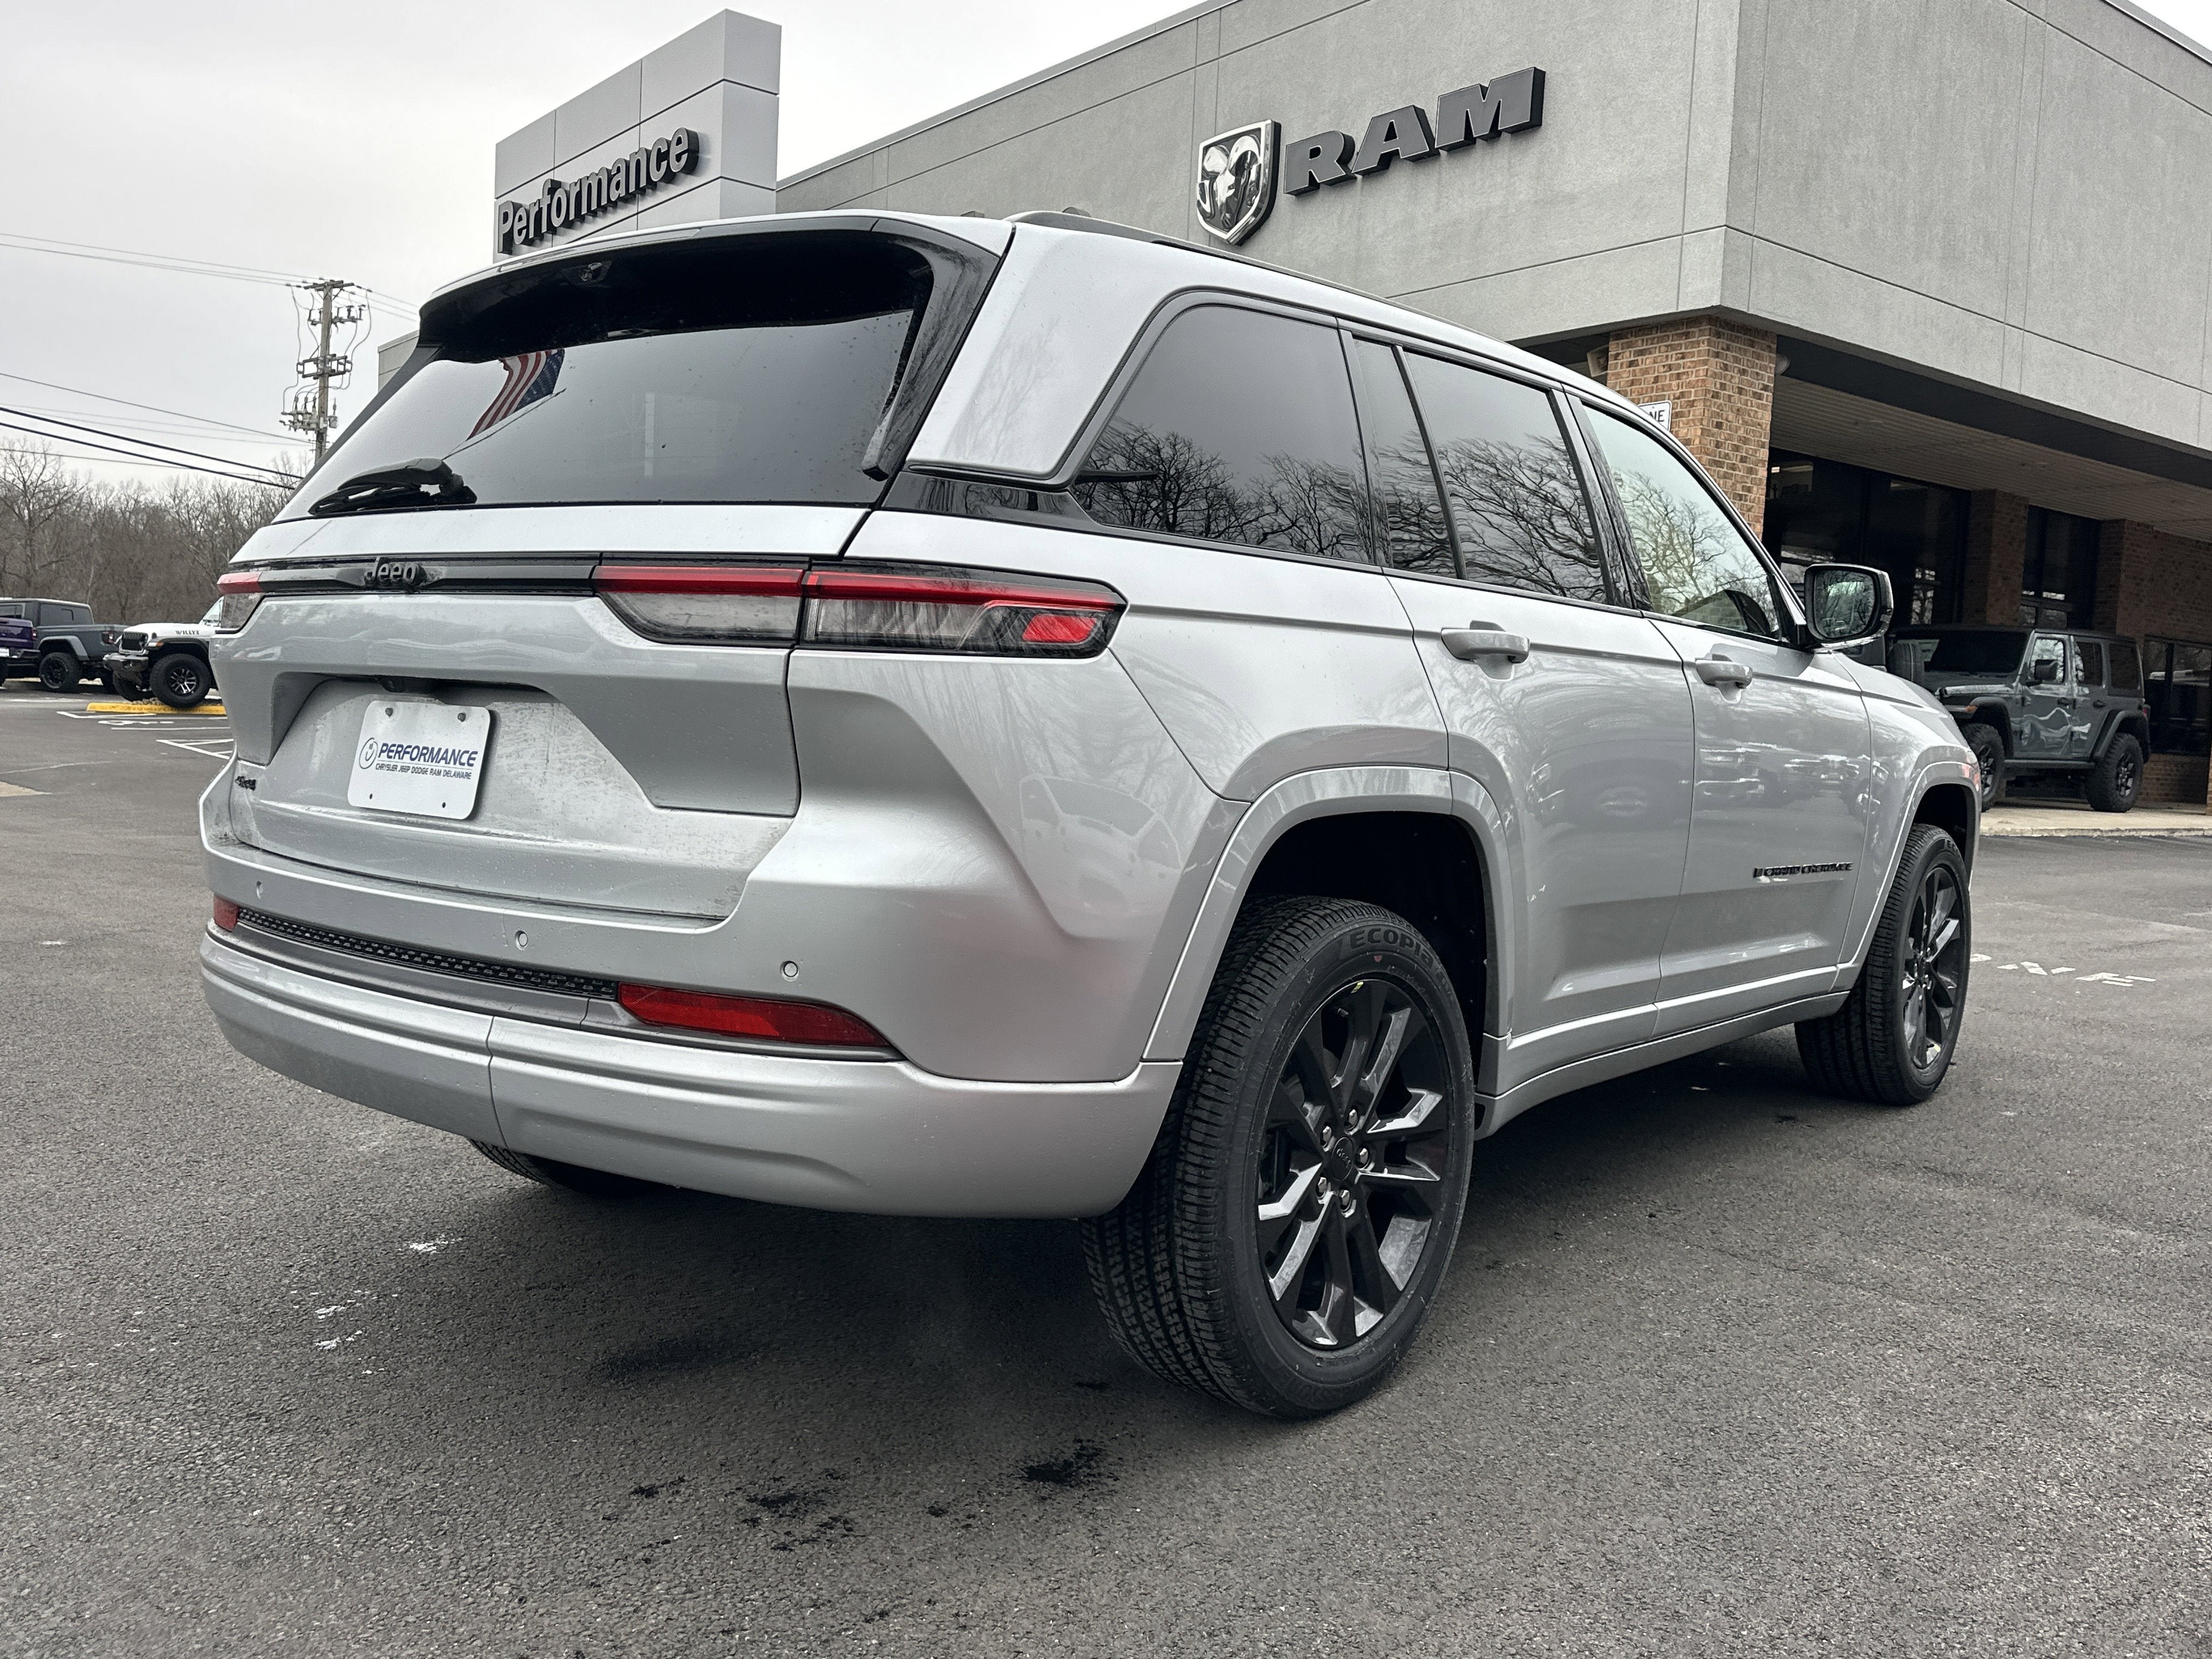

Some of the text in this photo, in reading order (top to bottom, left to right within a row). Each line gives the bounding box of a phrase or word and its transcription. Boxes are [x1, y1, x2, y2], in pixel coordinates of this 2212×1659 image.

[1284, 67, 1546, 196] RAM
[498, 128, 699, 254] Performance
[375, 763, 398, 772] CHRYSLER
[411, 766, 428, 775] DODGE
[443, 770, 472, 780] DELAWARE
[378, 743, 478, 767] PERFORMANCE
